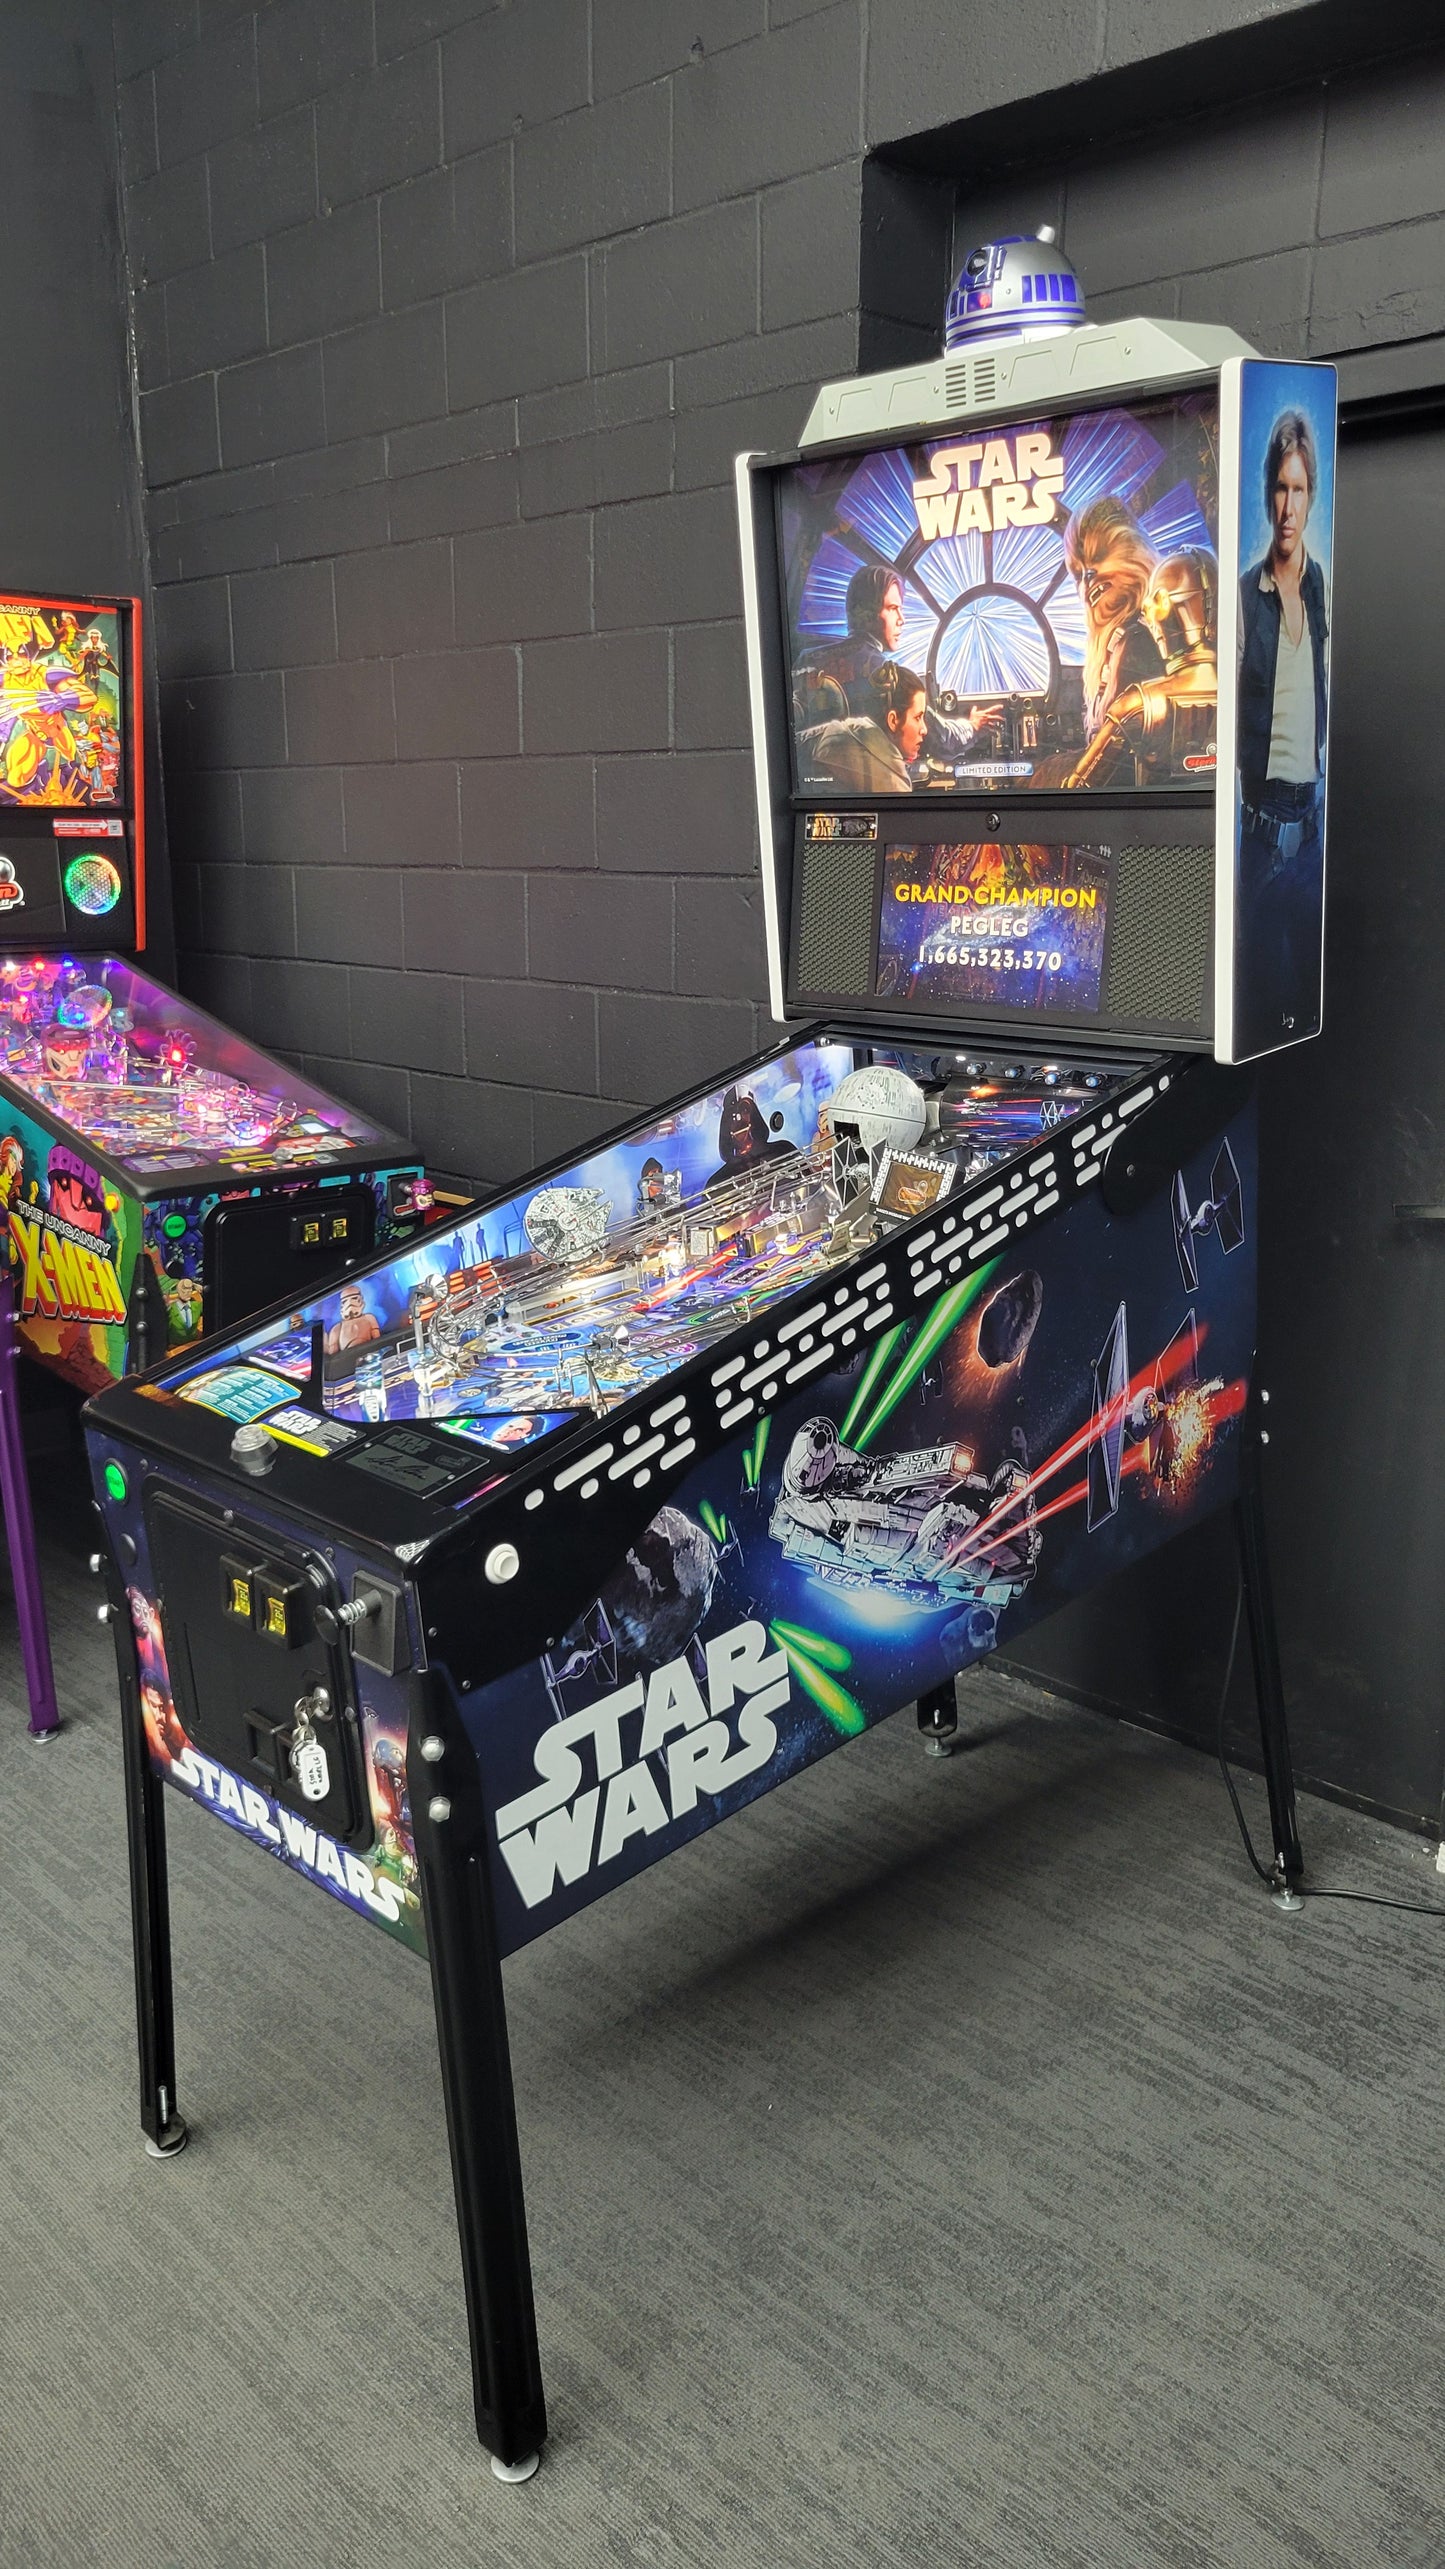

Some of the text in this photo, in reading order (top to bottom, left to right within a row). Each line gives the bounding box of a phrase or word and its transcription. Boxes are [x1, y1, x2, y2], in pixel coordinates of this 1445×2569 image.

[912, 432, 1064, 499] STAR
[914, 475, 1064, 541] WARS
[961, 765, 1027, 775] LIMITED EDITION
[895, 884, 1097, 908] GRAND CHAMPION
[950, 916, 1029, 937] PEGLEG
[919, 945, 1062, 971] 1,665,323,370
[16, 1200, 111, 1256] THE UNCANNY
[8, 1212, 127, 1325] X-MEN
[496, 1620, 789, 1840] STAR
[500, 1677, 790, 1909] WARS
[170, 1747, 405, 1922] STAR WARS
